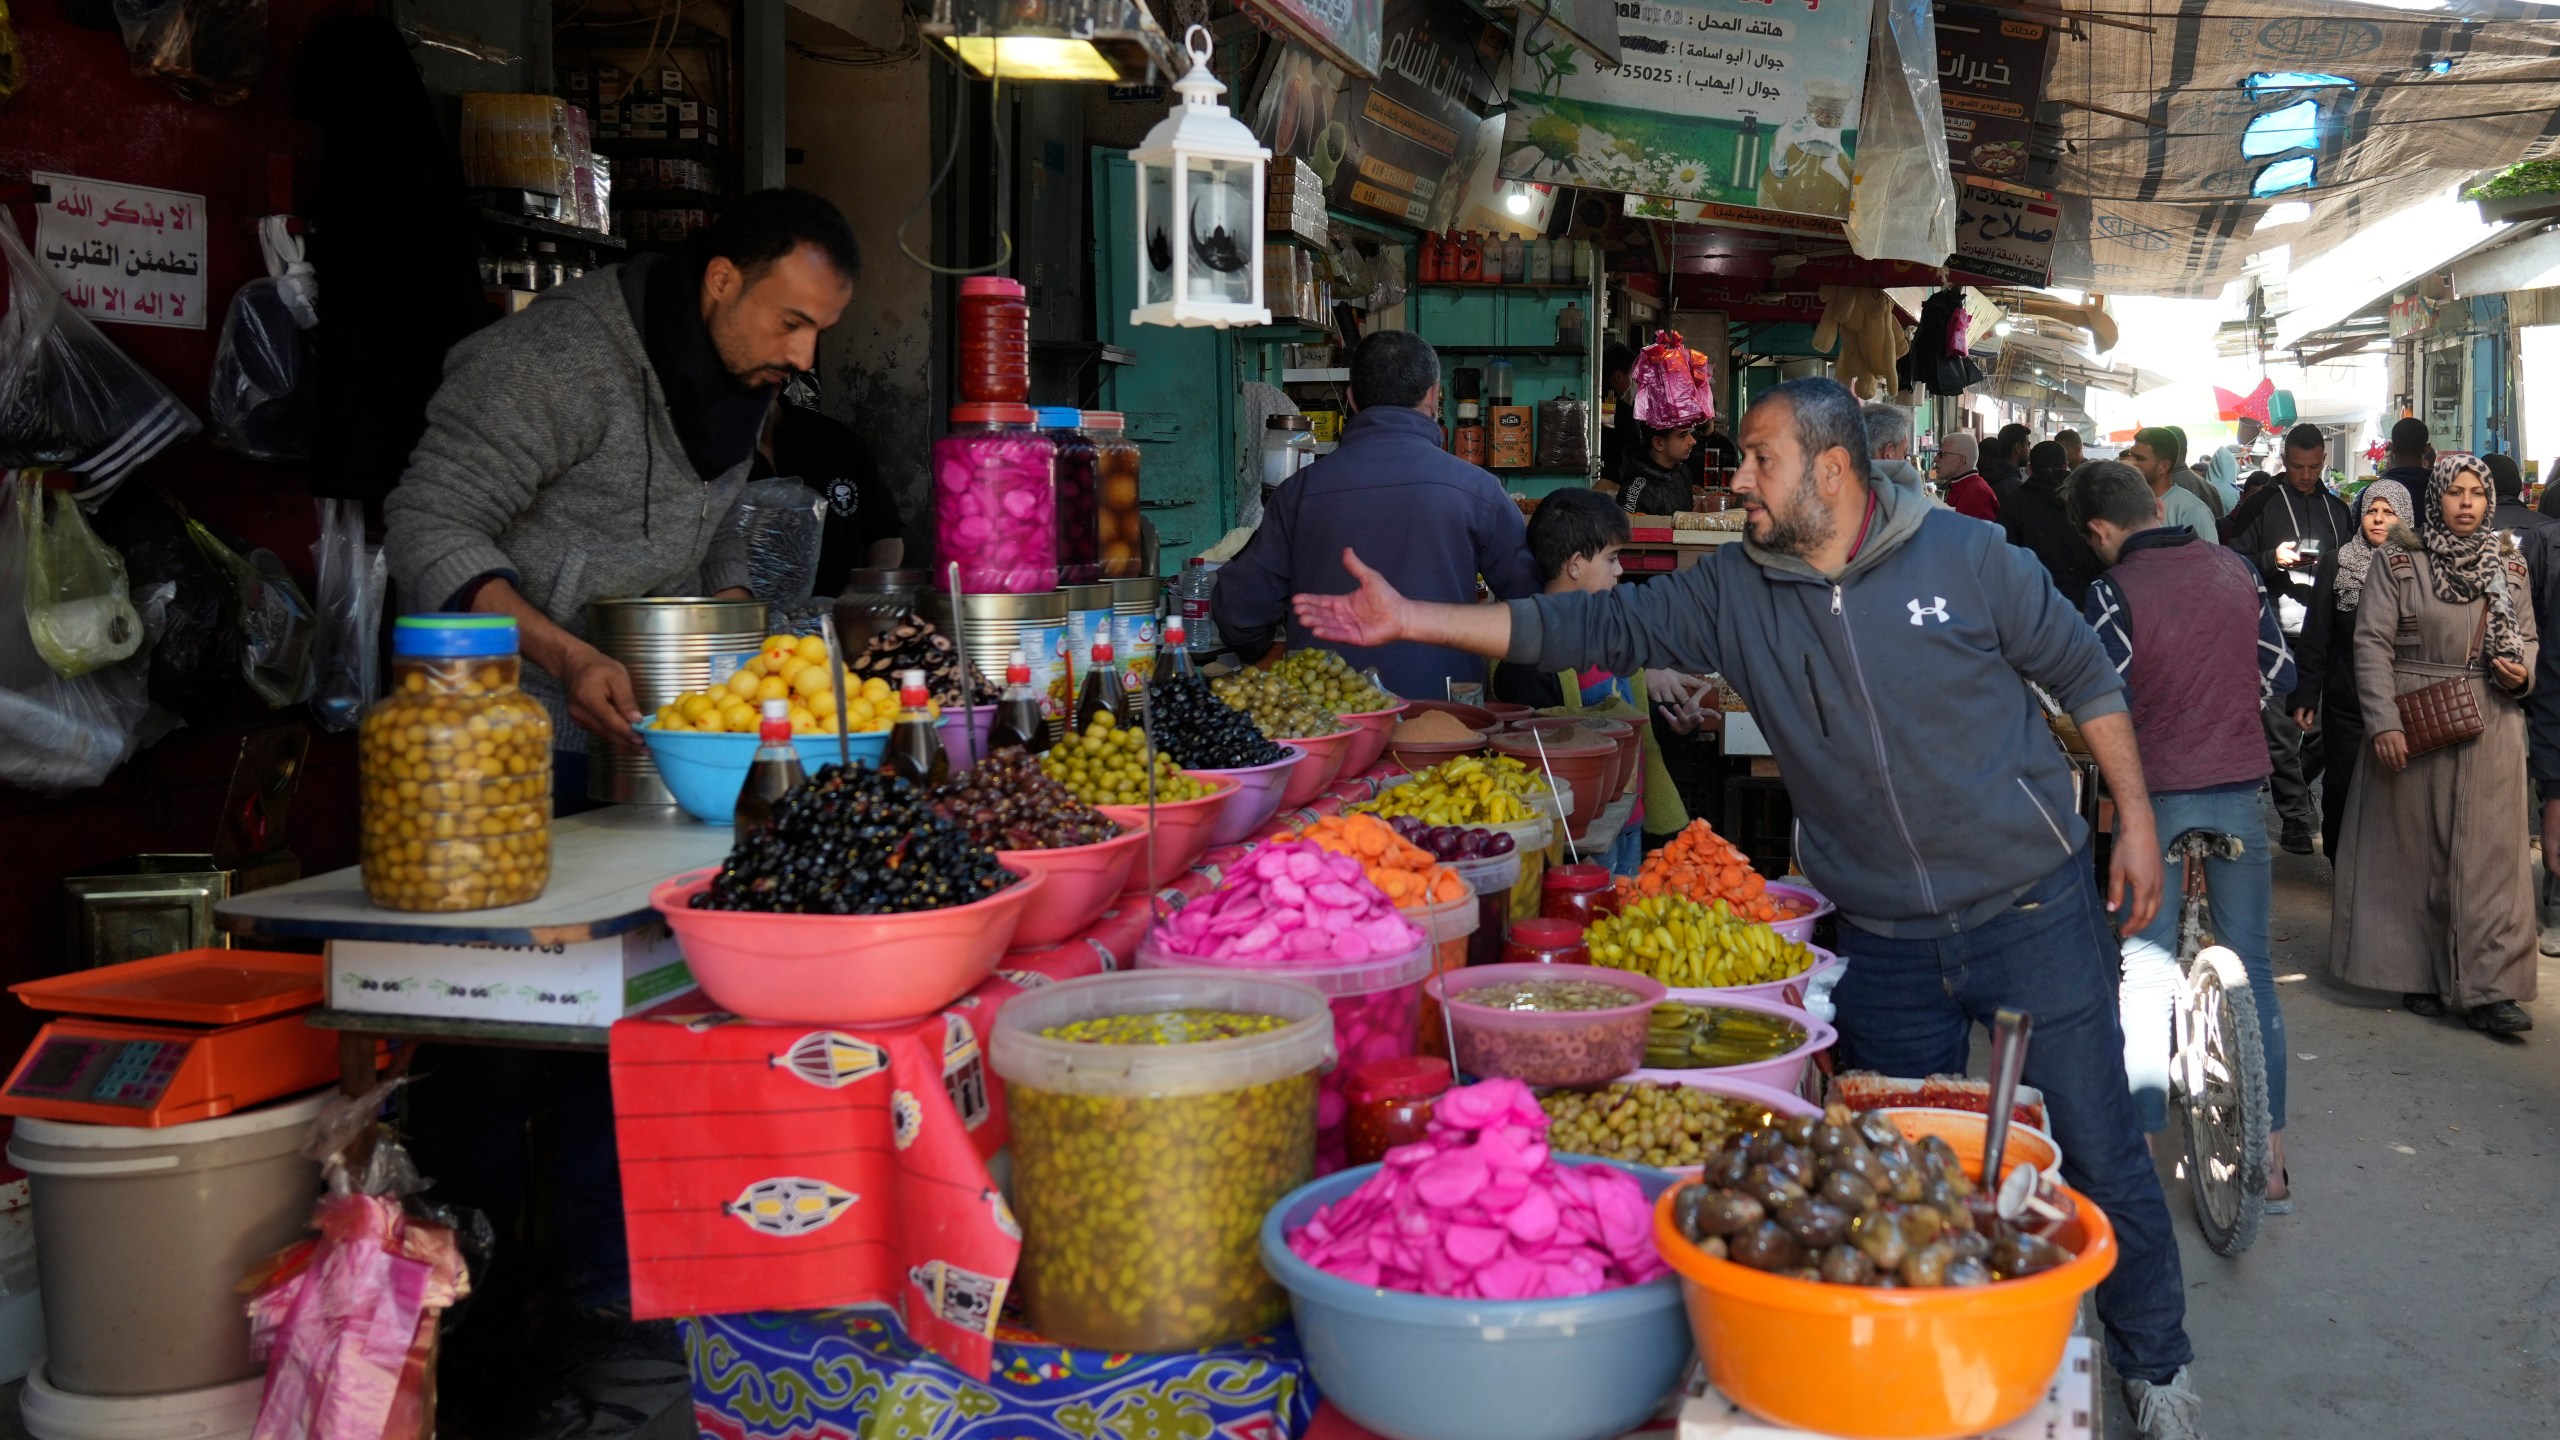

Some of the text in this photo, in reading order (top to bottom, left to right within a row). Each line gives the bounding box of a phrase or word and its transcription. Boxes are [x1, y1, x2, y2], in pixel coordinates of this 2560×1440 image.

[1698, 14, 1783, 37] هاتف المحل
[2004, 26, 2038, 36] محلات
[1688, 43, 1723, 60] اسامة
[1726, 49, 1744, 66] أبو
[1754, 50, 1785, 71] جوال
[1938, 50, 2010, 89] خيرات
[1694, 74, 1735, 95] إيهاب
[1747, 81, 1781, 101] جوال
[57, 185, 93, 217] الله
[1975, 190, 2023, 209] محلات
[96, 199, 164, 234] بذكر
[1980, 211, 2054, 243] صلاح
[46, 240, 198, 277] تطمئن القلوب
[102, 286, 126, 316] إلا
[134, 291, 163, 319] إله
[170, 293, 187, 317] لا
